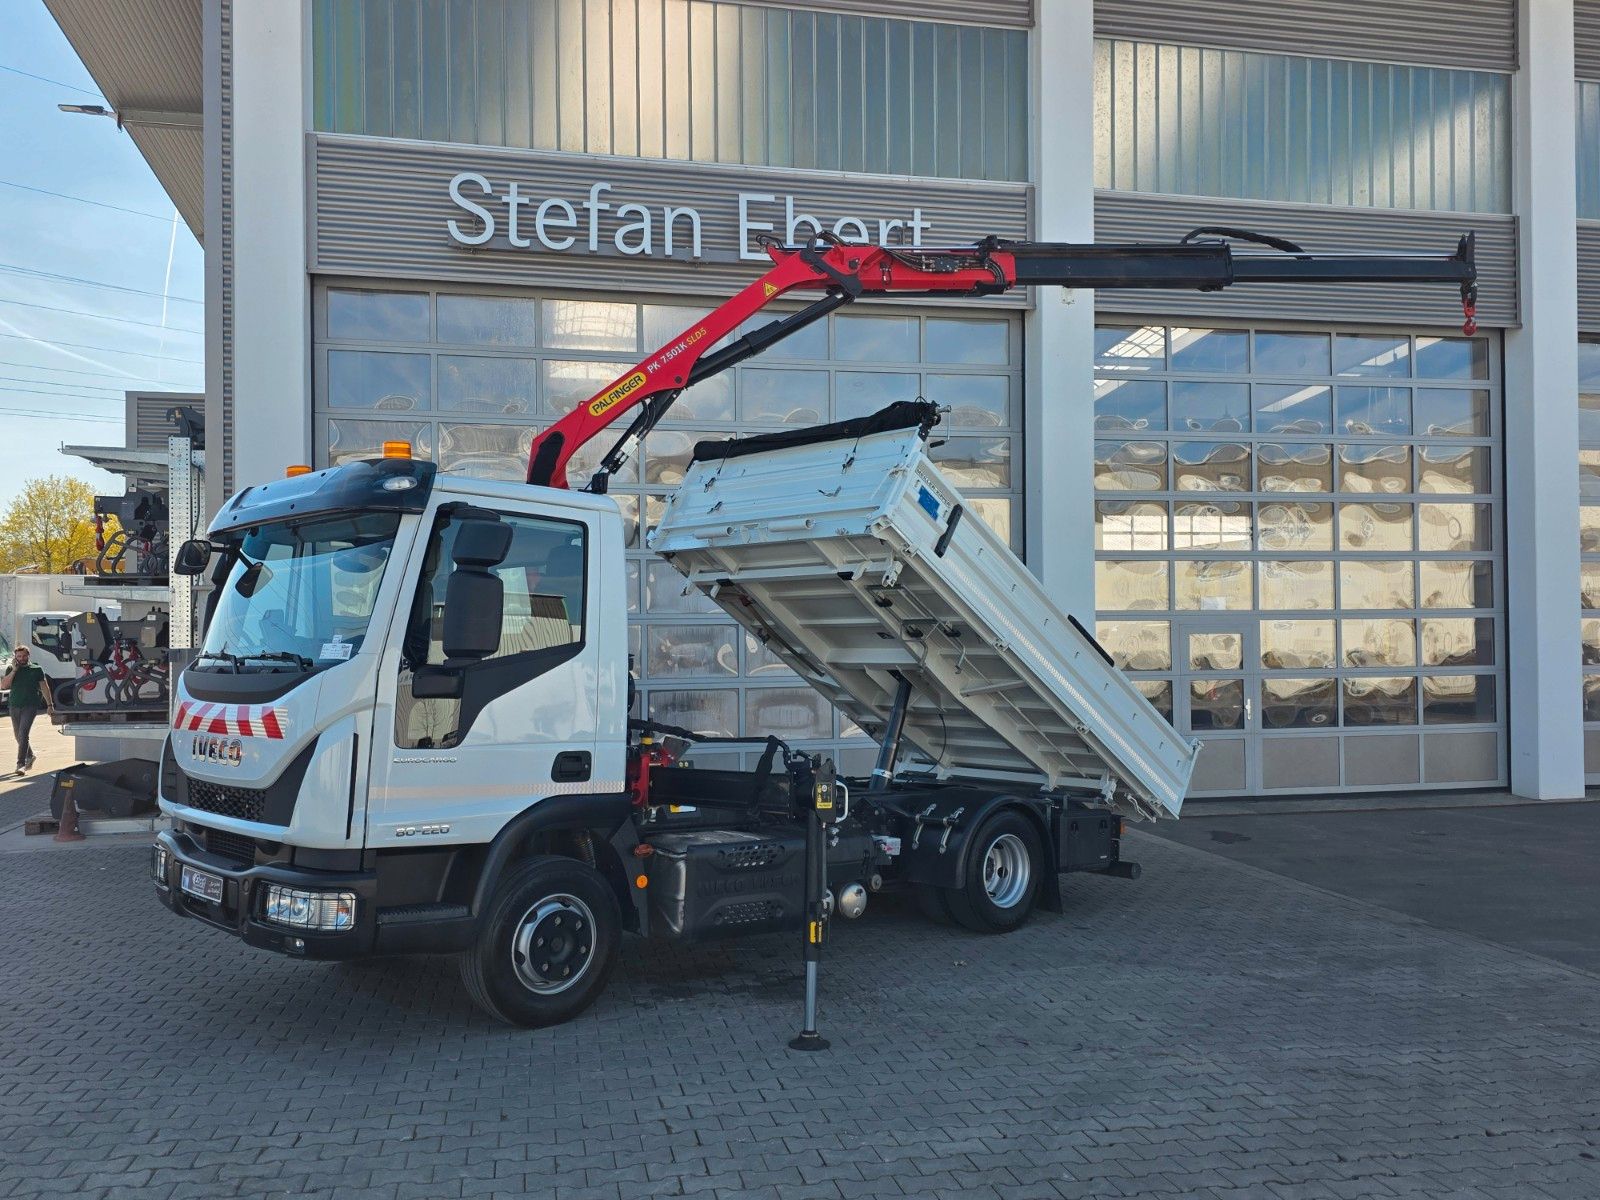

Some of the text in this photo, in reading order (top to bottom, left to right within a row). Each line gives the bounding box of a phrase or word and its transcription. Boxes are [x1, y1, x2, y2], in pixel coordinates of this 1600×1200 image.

[446, 172, 931, 260] Stefan Ebert
[647, 361, 661, 374] PK
[686, 327, 706, 345] SLD5
[592, 374, 643, 413] PALFINGER
[192, 734, 242, 767] IVECO
[393, 756, 457, 764] EUROCARGO
